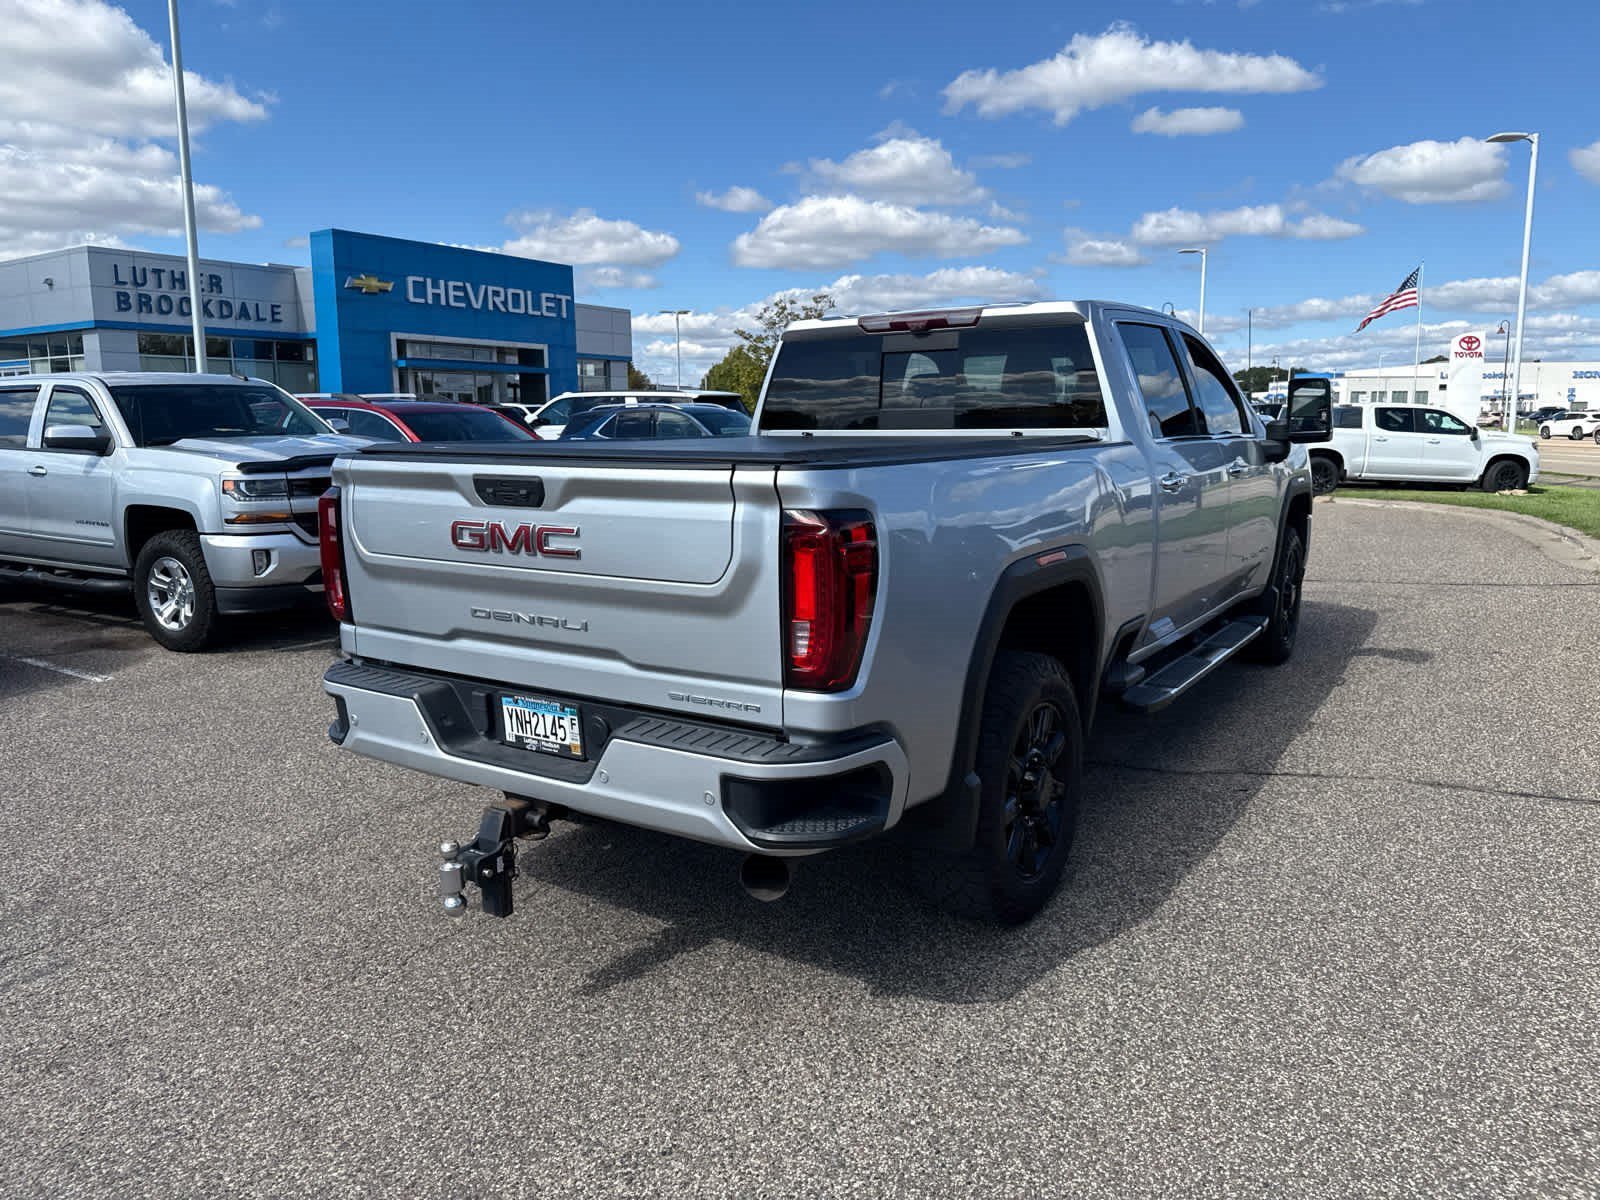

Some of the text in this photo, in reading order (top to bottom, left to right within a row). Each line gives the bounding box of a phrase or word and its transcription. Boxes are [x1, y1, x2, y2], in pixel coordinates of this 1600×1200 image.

[406, 275, 571, 318] CHEVROLET
[451, 520, 582, 561] GMC
[470, 606, 589, 632] DENALI
[667, 691, 761, 713] SIERRA
[506, 707, 567, 742] YNH2145
